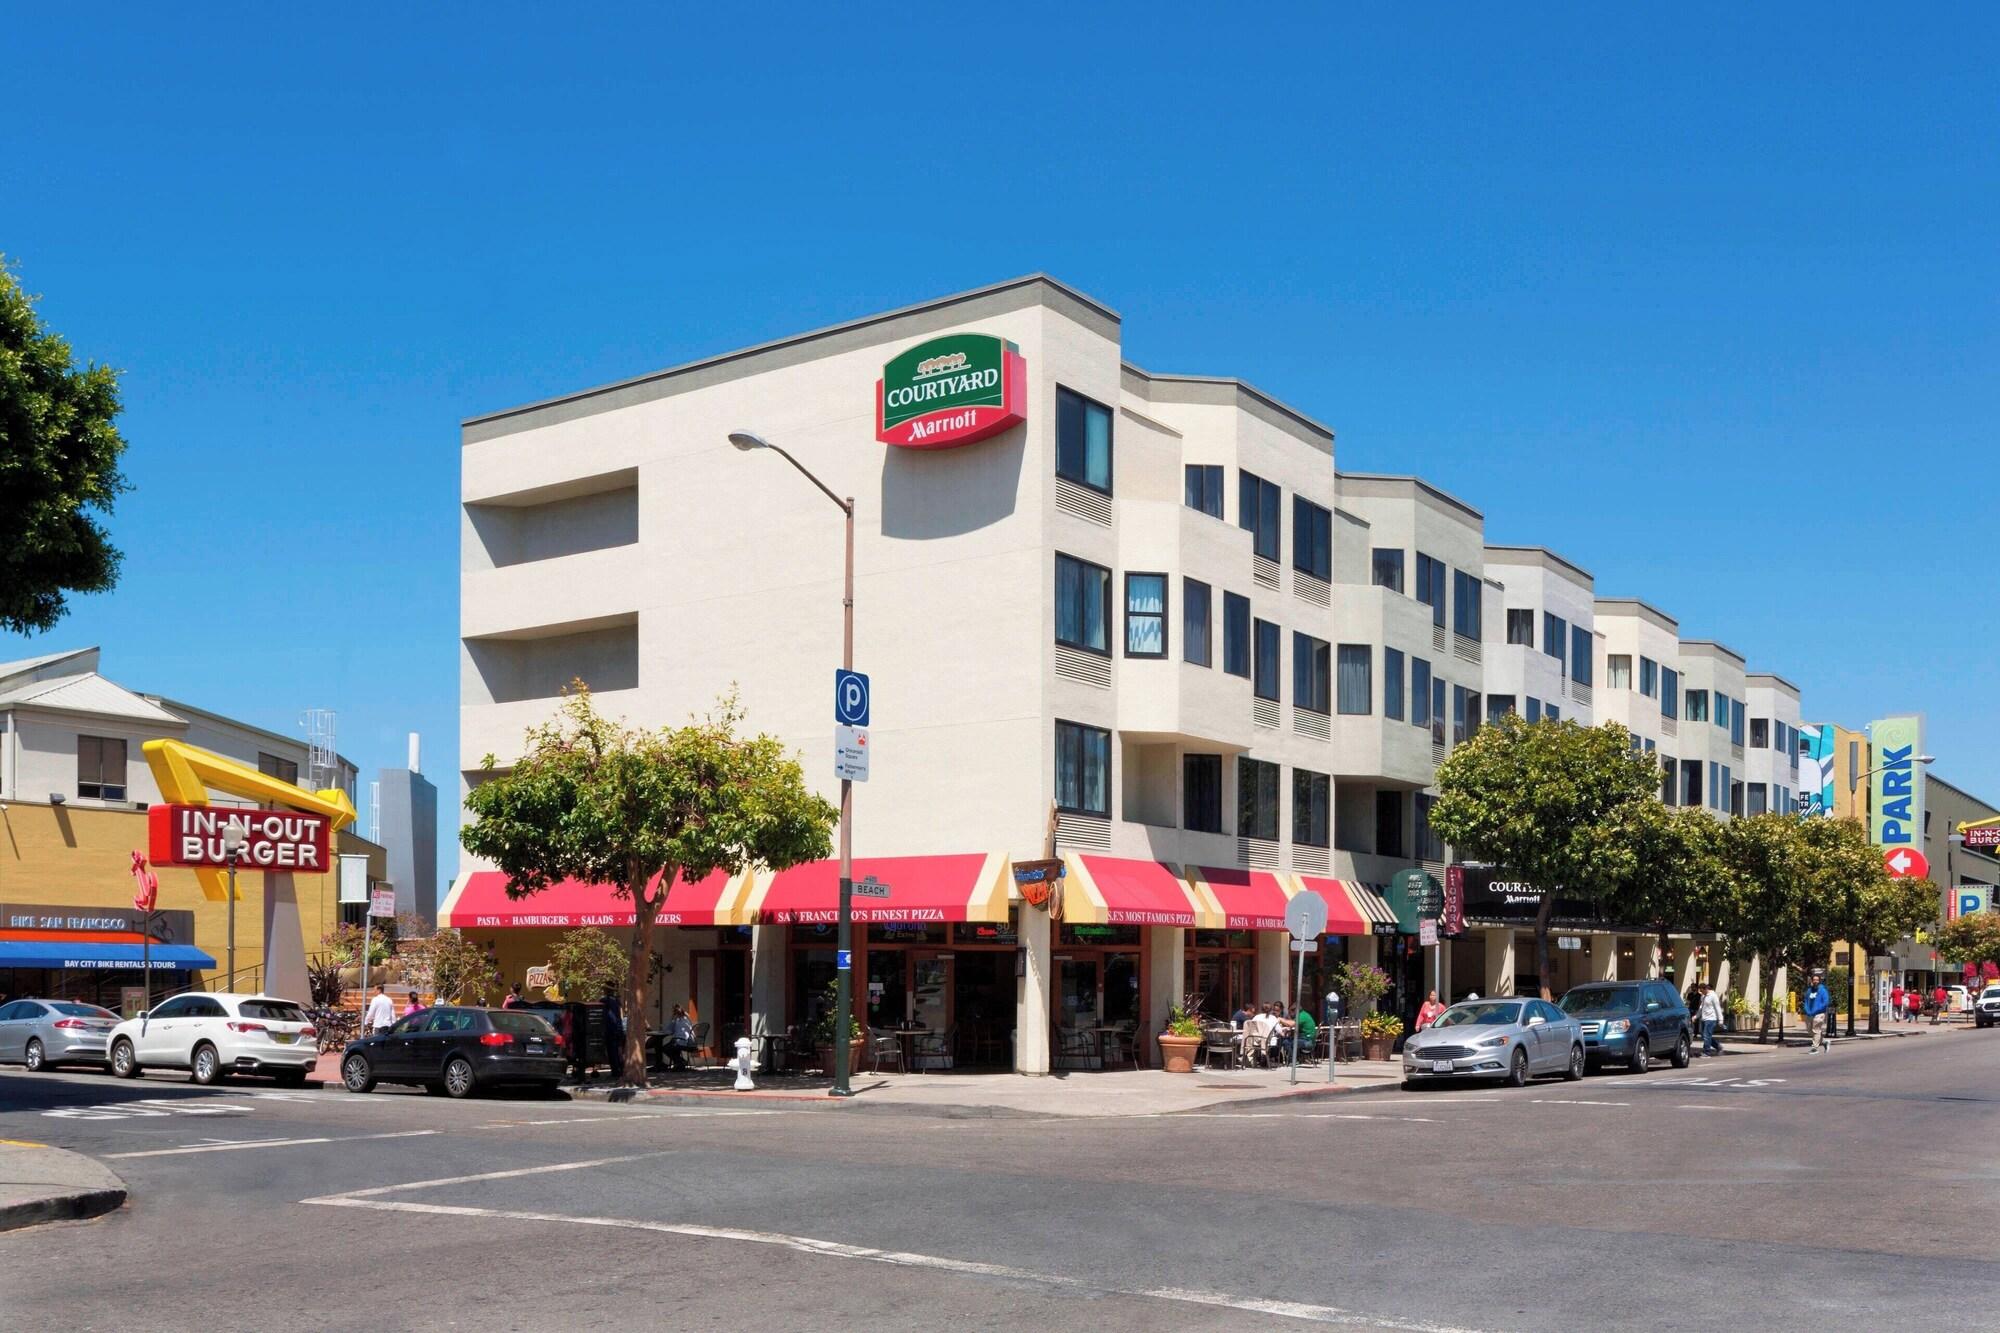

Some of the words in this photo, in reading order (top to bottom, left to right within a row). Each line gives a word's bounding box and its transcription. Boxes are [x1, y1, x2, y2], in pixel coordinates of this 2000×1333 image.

[887, 368, 998, 408] COURTYARD
[907, 409, 977, 442] Marriott
[1882, 744, 1912, 844] PARK
[182, 810, 321, 843] IN-N-OUT
[182, 836, 318, 867] BURGER
[857, 885, 885, 895] BEACH
[1504, 894, 1540, 904] Marriott
[11, 915, 35, 928] BIKE
[67, 918, 126, 929] FRANCISCO
[476, 917, 500, 926] PASTA
[512, 915, 569, 925] HAMBURGERS
[580, 915, 614, 925] SALADS
[777, 912, 798, 922] SAN
[800, 910, 868, 921] FRANCIO'S
[871, 909, 908, 920] FINEST
[911, 909, 944, 920] PIZZA
[1125, 911, 1147, 922] MOST
[1146, 912, 1176, 923] FAMOUS
[1175, 913, 1196, 924] PIZZA
[1230, 916, 1249, 927] PASTA
[64, 960, 79, 968] BAY
[80, 960, 97, 968] CITY
[114, 961, 146, 969] RENTALS
[152, 961, 176, 969] TOURS
